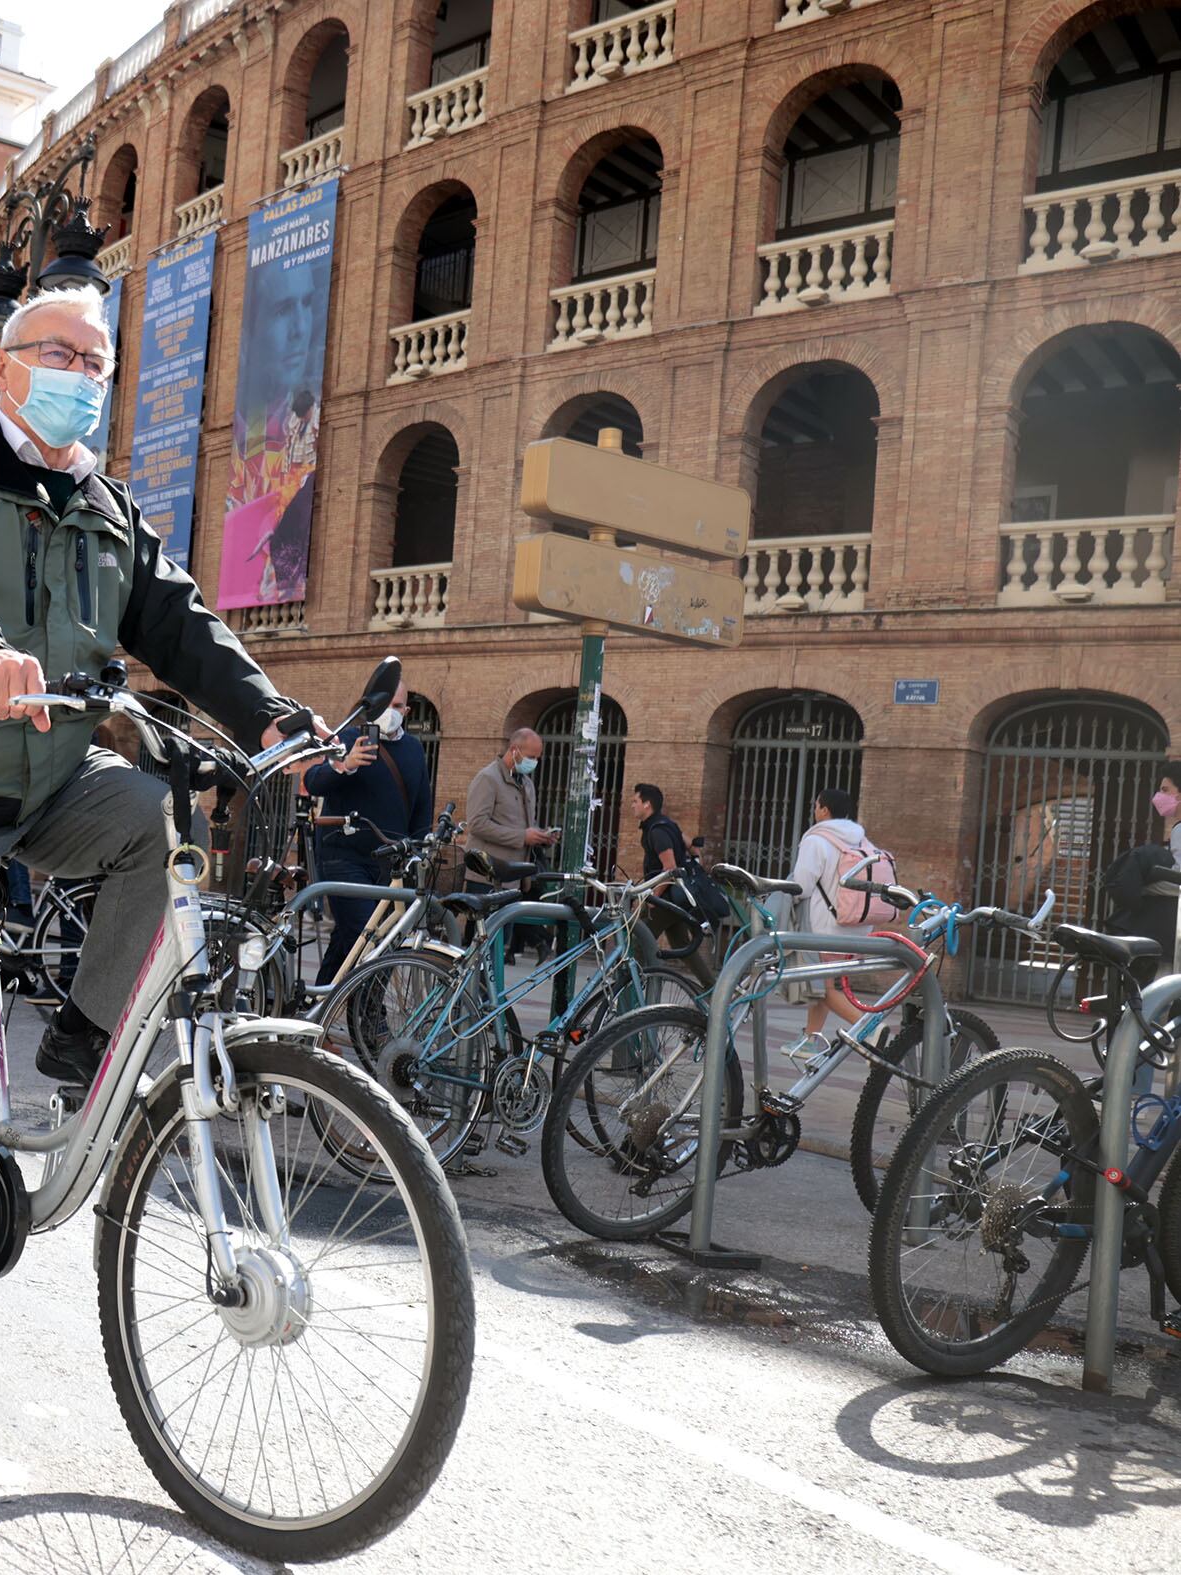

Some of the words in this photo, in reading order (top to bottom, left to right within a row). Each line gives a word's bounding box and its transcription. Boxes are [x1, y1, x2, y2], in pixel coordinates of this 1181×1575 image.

[263, 199, 298, 223] FALLAS
[299, 188, 323, 208] 2022
[251, 219, 330, 268] MANZANARES
[305, 244, 331, 261] MARZO
[811, 725, 823, 737] 17
